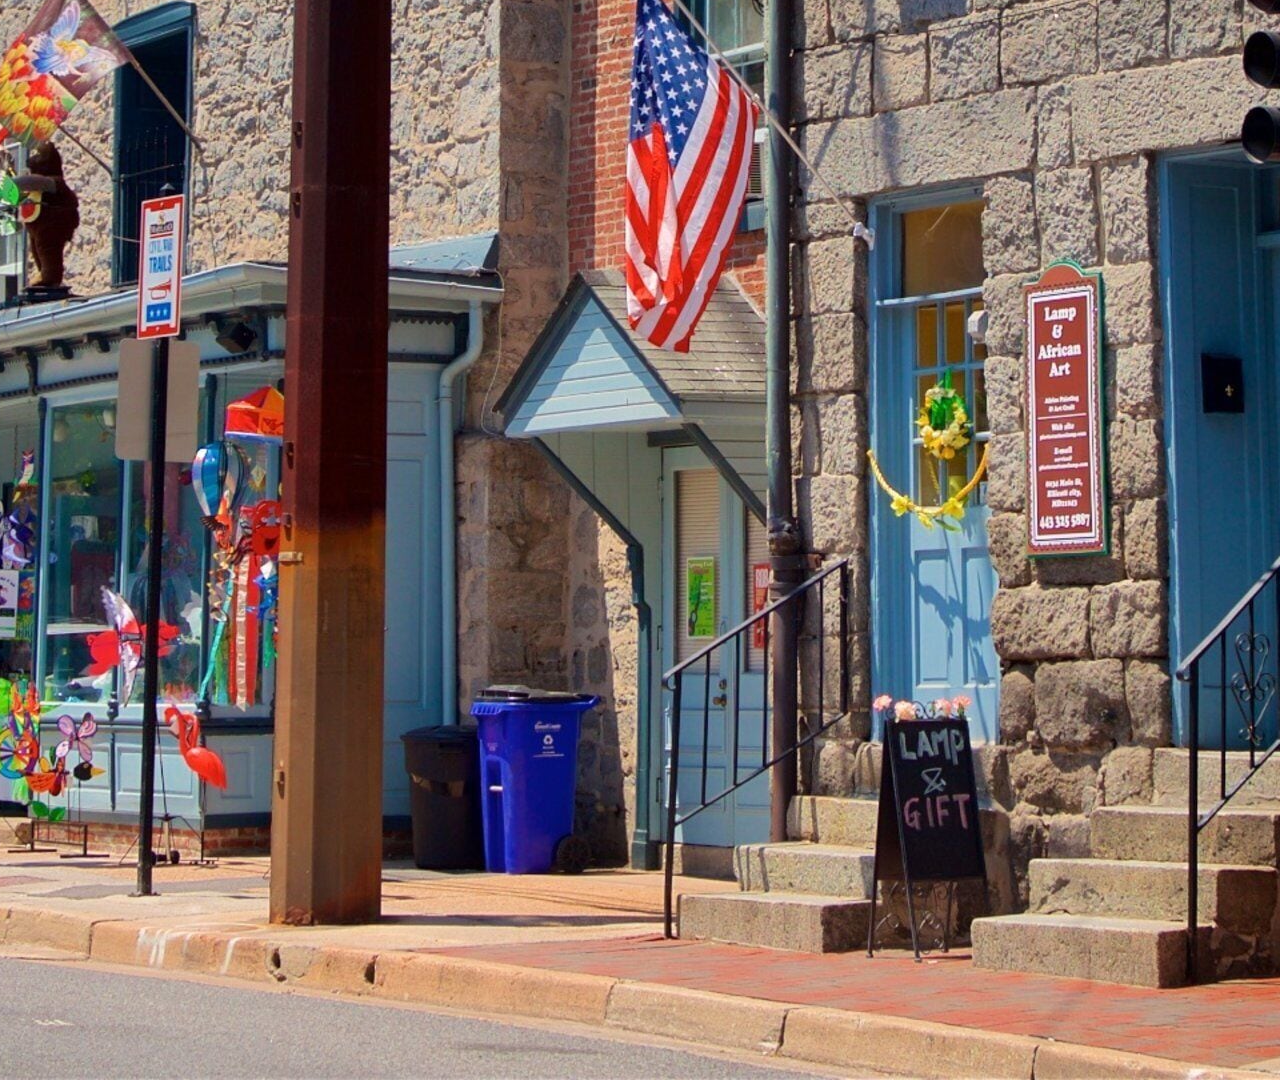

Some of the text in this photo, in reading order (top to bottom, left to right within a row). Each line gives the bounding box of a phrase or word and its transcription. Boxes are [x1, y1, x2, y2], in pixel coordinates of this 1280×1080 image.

[149, 255, 172, 273] TRAILS
[1044, 306, 1077, 322] Lamp
[1052, 324, 1063, 339] &
[1038, 343, 1082, 360] African
[1049, 362, 1071, 378] Art
[1040, 515, 1054, 529] 443
[1055, 514, 1069, 528] 325
[899, 728, 964, 766] LAMP
[920, 767, 947, 796] &
[903, 793, 970, 831] GIFT
